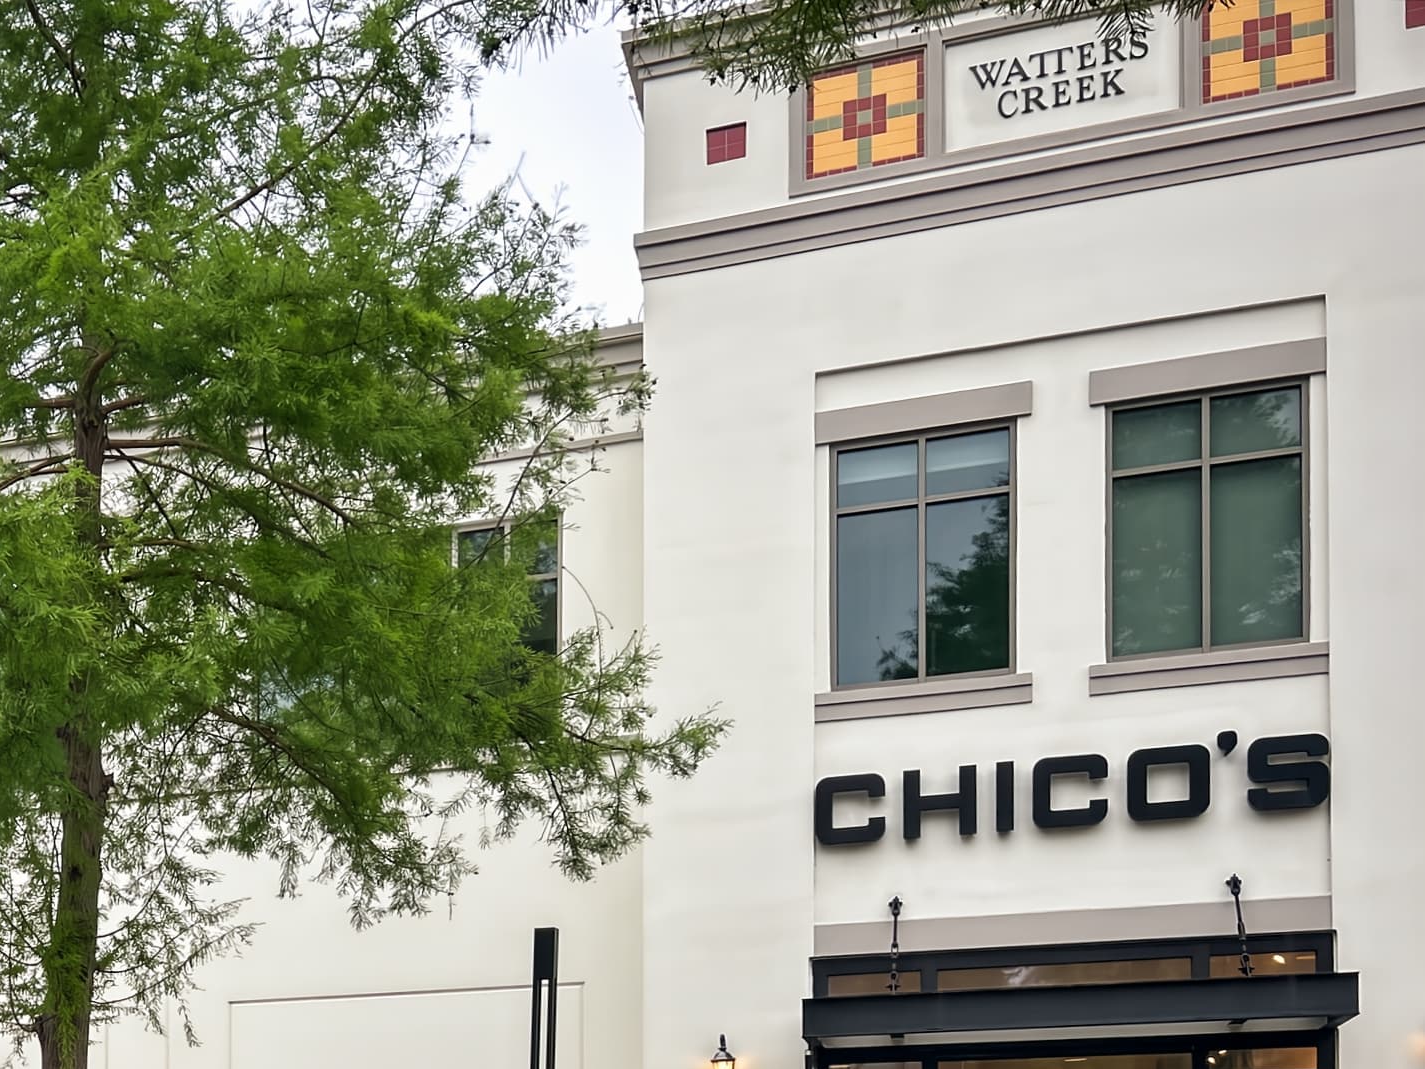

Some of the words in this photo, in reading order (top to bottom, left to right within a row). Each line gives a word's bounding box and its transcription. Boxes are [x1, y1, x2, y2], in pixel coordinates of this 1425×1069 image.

[969, 31, 1149, 90] WATTERS
[997, 68, 1126, 119] CREEK
[815, 730, 1331, 846] CHICO'S
